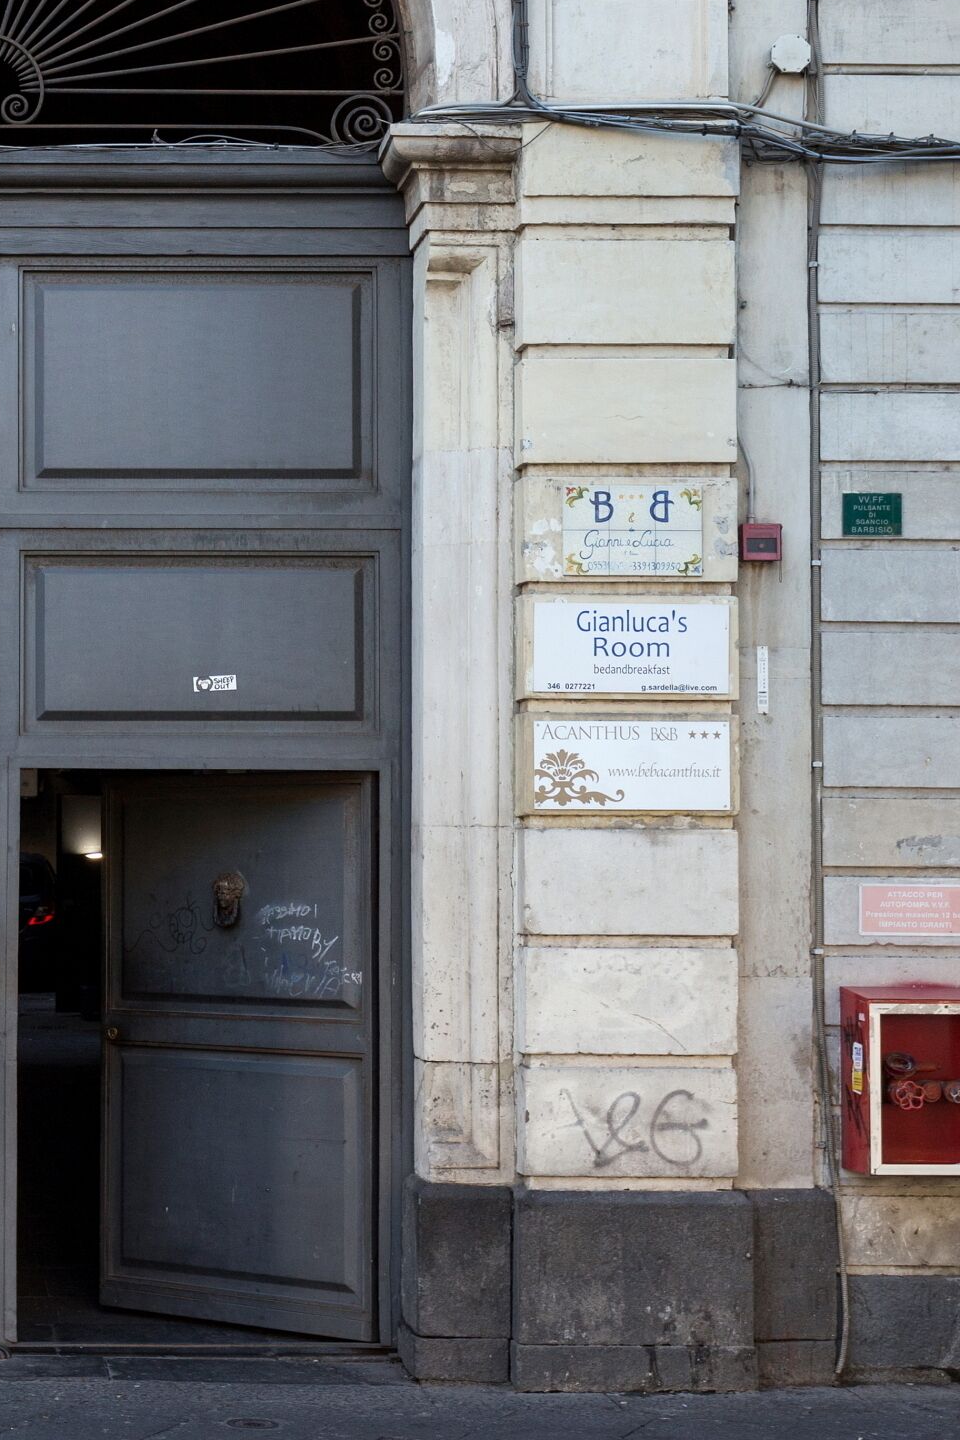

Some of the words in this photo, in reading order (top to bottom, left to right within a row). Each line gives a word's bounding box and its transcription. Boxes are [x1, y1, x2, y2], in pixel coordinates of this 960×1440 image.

[580, 530, 625, 559] Gianni
[632, 530, 674, 547] Lucia
[576, 610, 688, 633] Gianluca's
[593, 637, 670, 657] Room
[593, 664, 670, 675] bedandbreakfast
[547, 682, 561, 690] 346
[565, 682, 595, 690] 0277221
[641, 683, 717, 692] g.sardella@live.com
[541, 724, 640, 741] ACANTHUS
[650, 727, 678, 741] B&B
[608, 762, 722, 778] www.bebacanthus.it
